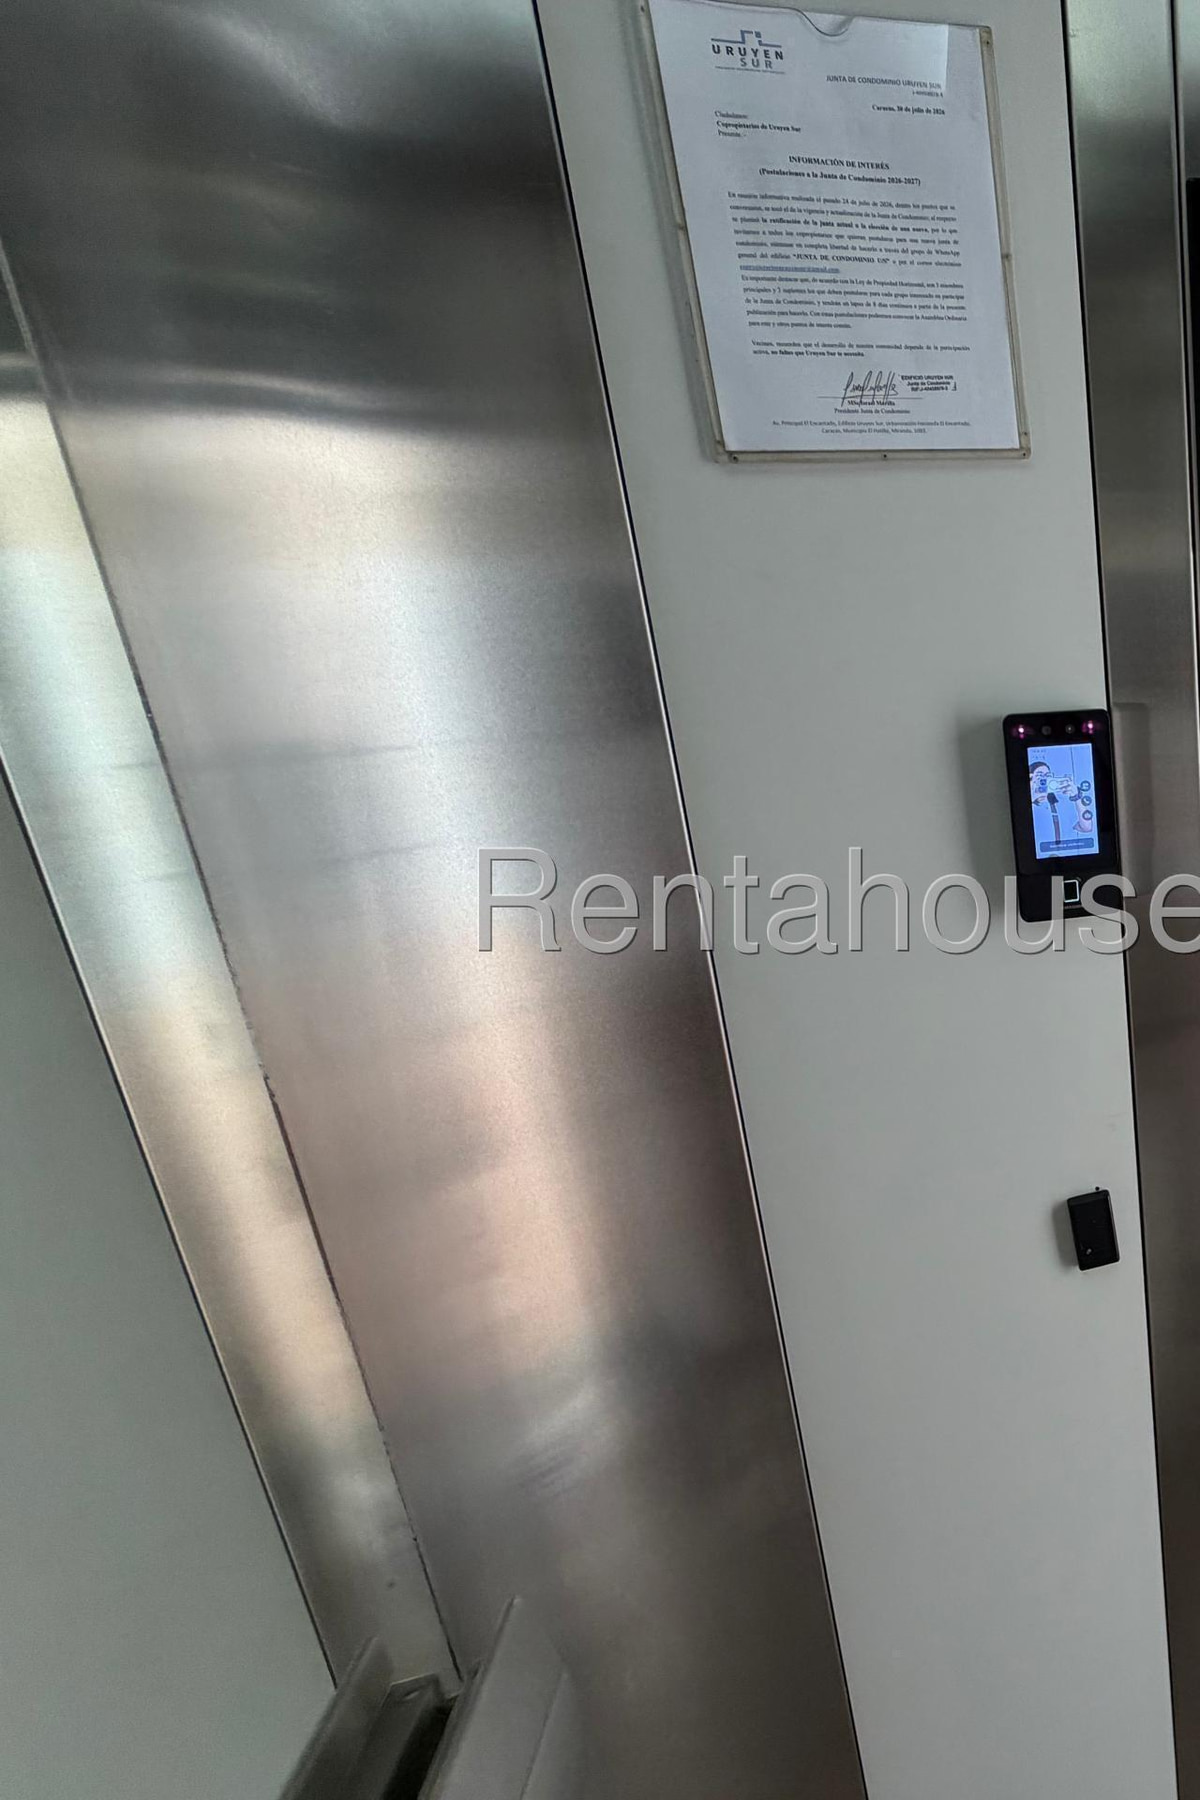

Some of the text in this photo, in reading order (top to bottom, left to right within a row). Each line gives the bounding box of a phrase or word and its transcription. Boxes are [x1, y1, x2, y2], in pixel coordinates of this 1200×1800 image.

[711, 44, 784, 61] URUYEN
[740, 58, 773, 69] SUR
[826, 74, 846, 83] JUNTA
[857, 76, 900, 86] CONDOMINIO
[788, 155, 845, 166] INFORMACIÓN
[857, 160, 890, 170] INTERÉS
[819, 170, 837, 179] Junta
[848, 173, 886, 183] Condominio
